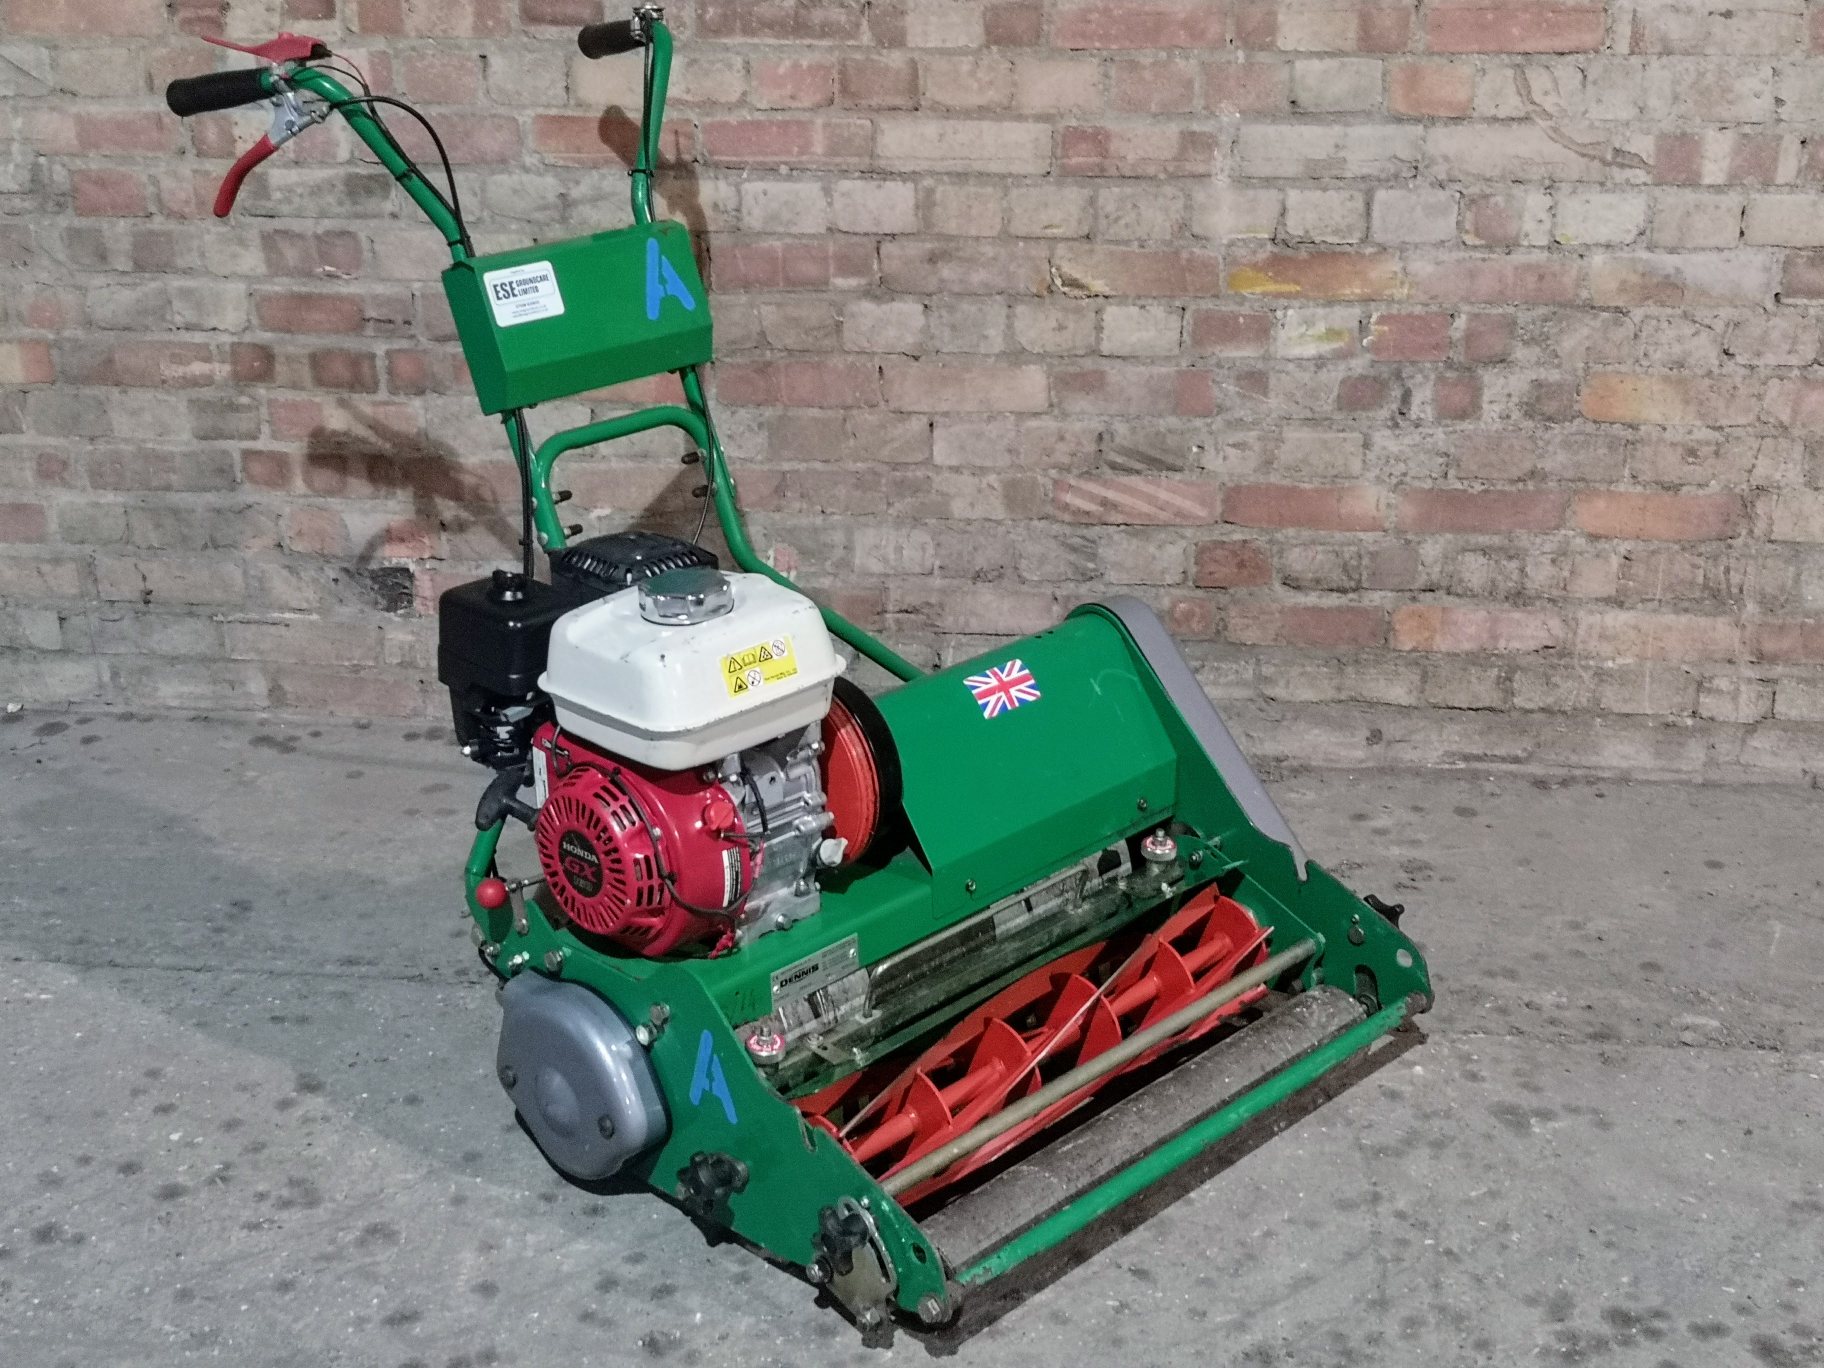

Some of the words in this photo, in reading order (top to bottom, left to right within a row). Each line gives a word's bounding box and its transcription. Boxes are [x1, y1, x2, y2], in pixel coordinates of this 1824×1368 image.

[492, 280, 518, 301] ESE
[515, 273, 550, 288] GROUNDCARE
[518, 285, 540, 297] LIMITED
[645, 237, 696, 321] A
[562, 841, 599, 865] HONDA
[564, 855, 598, 882] GX
[779, 963, 820, 988] DENNIS
[689, 1029, 738, 1125] A
